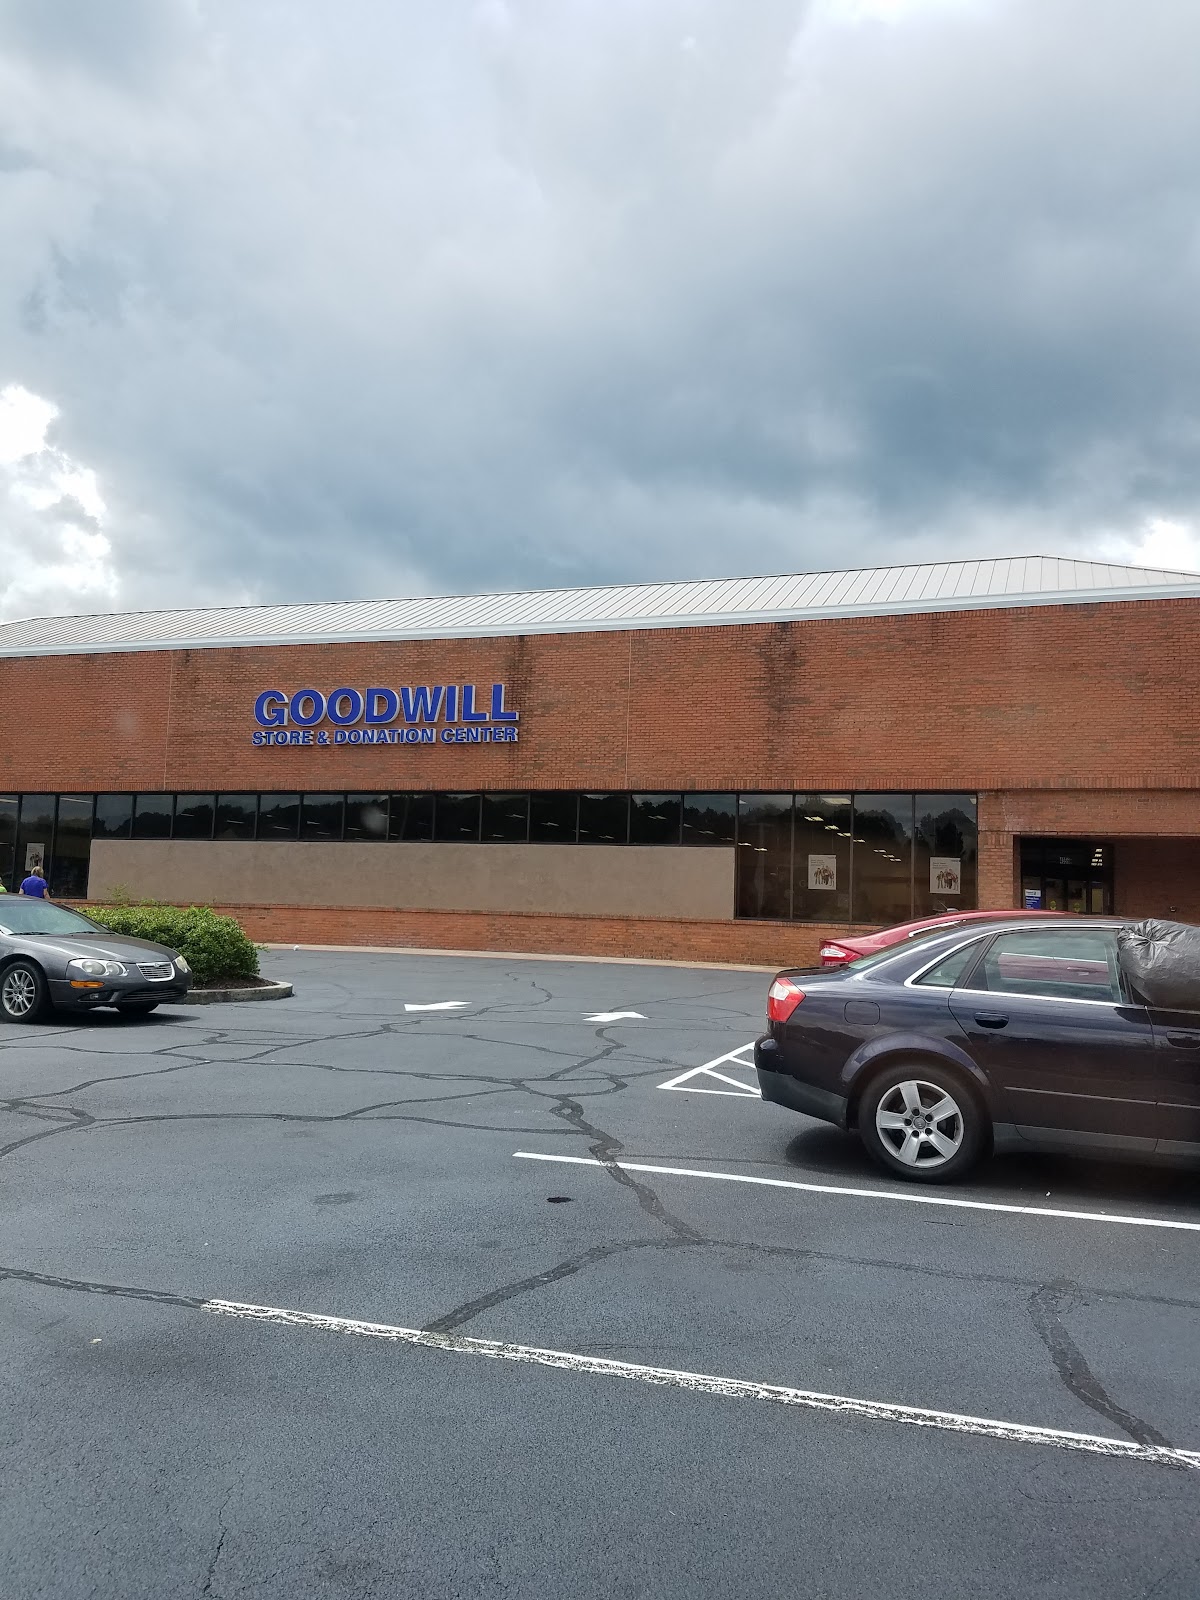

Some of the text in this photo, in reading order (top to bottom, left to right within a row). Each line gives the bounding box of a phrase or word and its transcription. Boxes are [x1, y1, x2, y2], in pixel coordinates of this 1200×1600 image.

[254, 684, 519, 727] GOODWILL
[252, 726, 518, 746] STORE & DONATION CENTER
